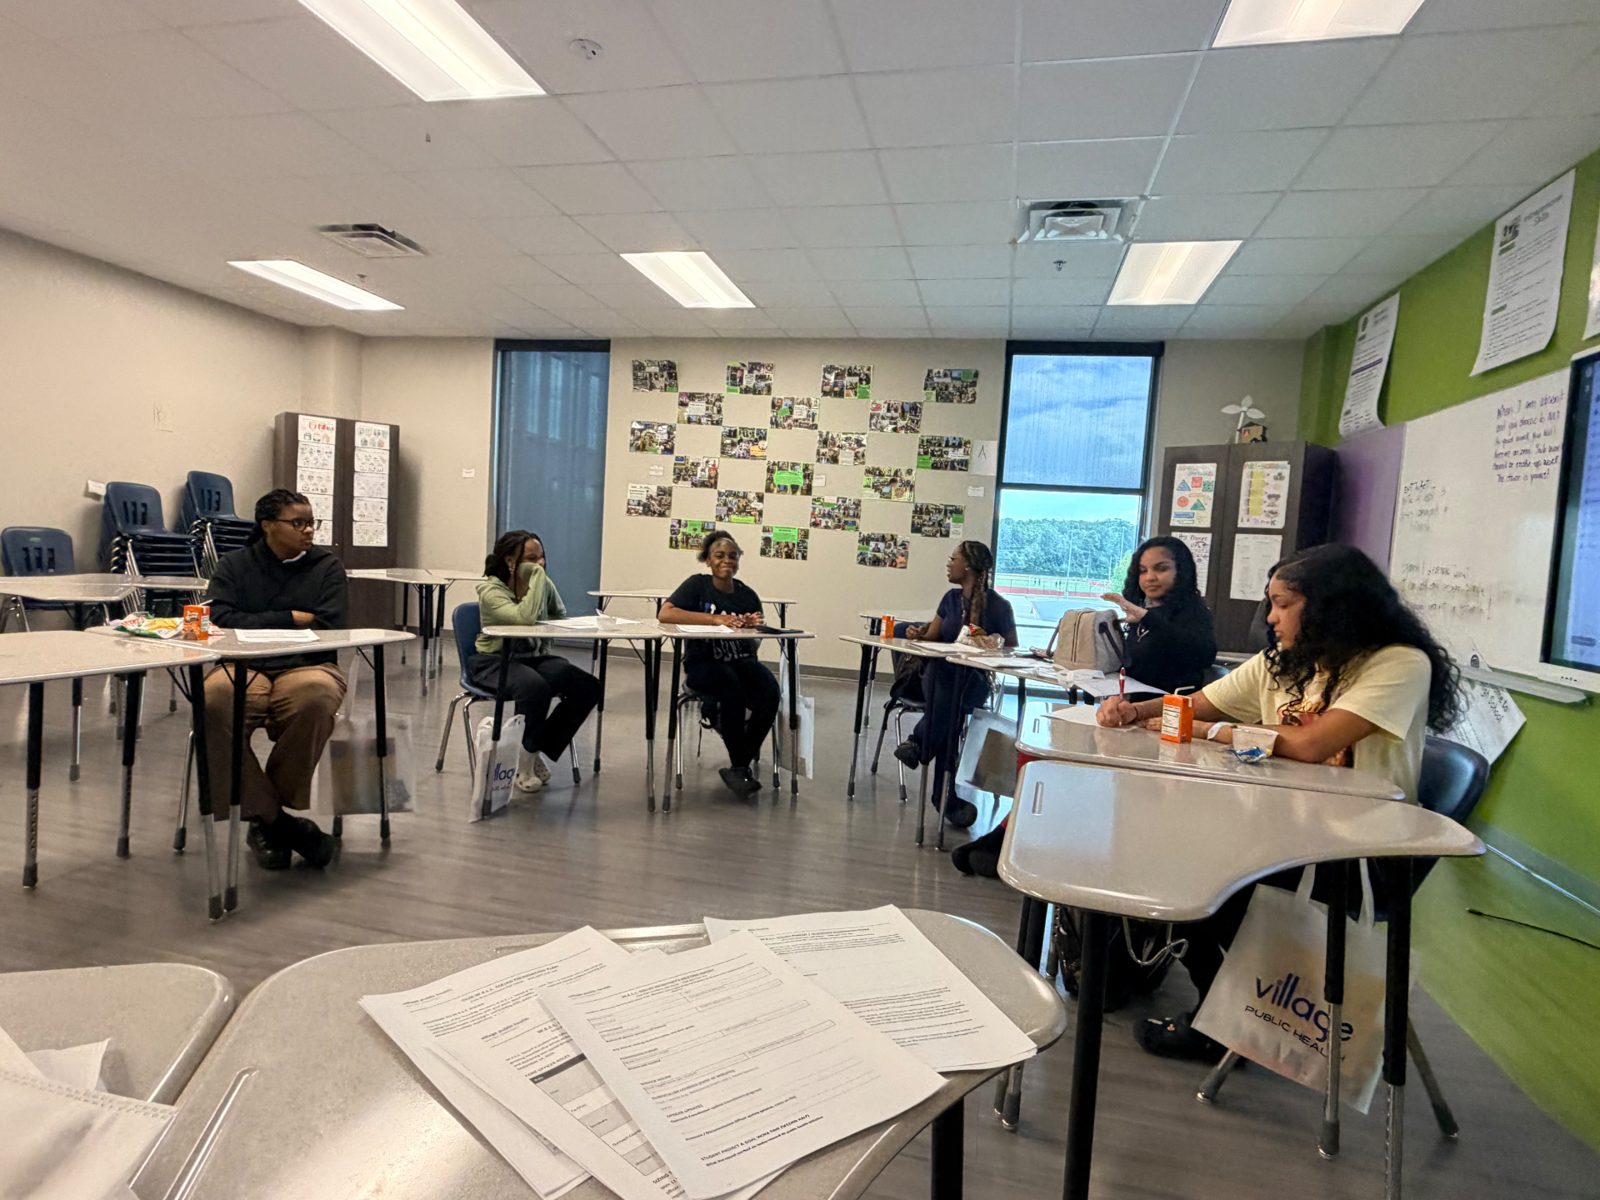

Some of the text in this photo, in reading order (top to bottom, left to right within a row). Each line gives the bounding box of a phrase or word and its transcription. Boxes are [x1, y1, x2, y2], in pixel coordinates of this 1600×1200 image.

[1245, 1005, 1346, 1062] PUBLIC HEAL
[1257, 973, 1353, 1042] village
